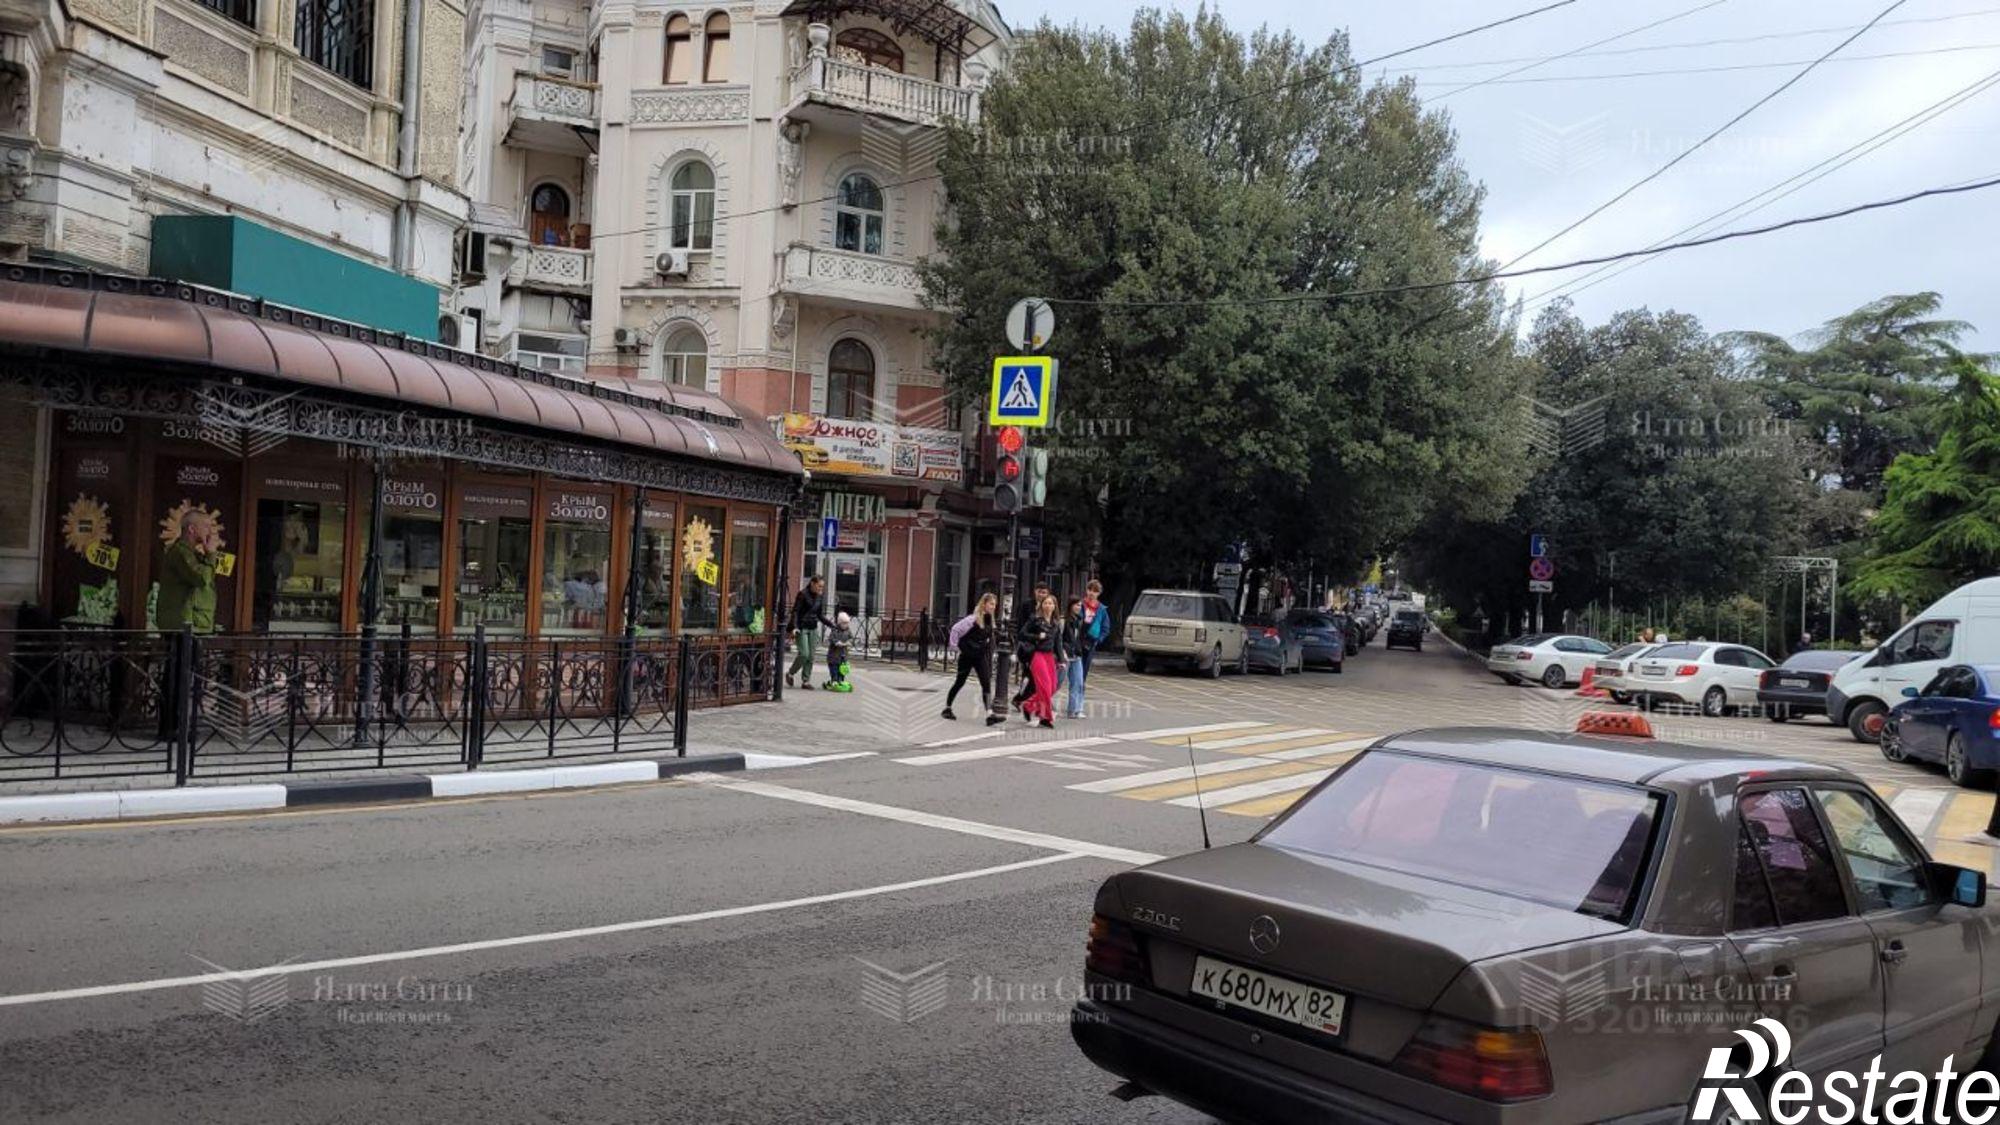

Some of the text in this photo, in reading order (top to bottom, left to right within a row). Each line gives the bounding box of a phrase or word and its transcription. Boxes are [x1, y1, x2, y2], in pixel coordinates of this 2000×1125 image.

[383, 493, 437, 509] ОЛОТО
[822, 491, 886, 524] АПТЕКА
[1307, 991, 1334, 1019] 82
